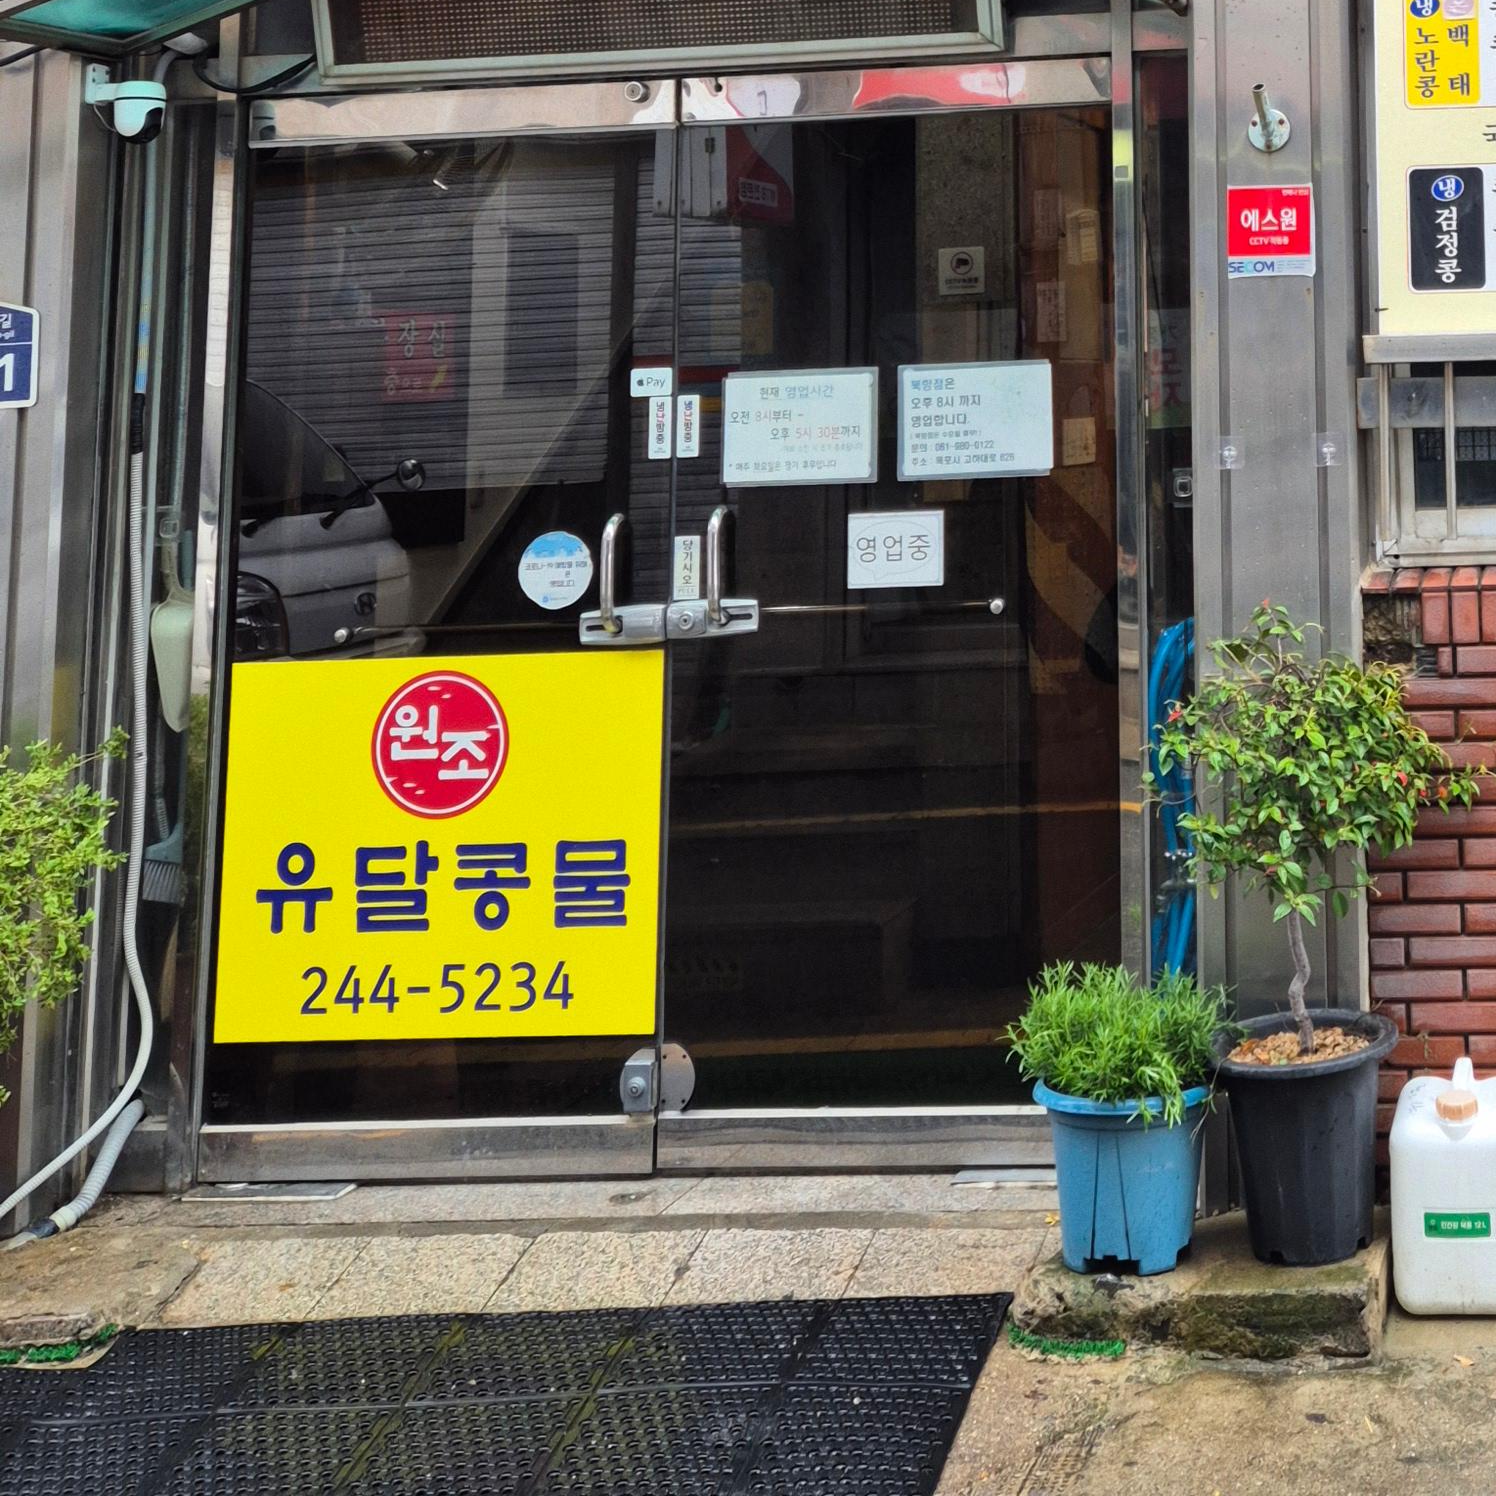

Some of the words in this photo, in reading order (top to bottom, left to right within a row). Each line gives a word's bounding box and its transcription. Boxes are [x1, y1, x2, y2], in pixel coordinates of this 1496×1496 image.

[1413, 27, 1440, 98] 노란콩
[1447, 24, 1470, 96] 백태
[1437, 178, 1457, 199] 냉
[1240, 207, 1297, 232] 에스원
[1434, 206, 1462, 283] 검정콩
[1228, 261, 1275, 273] SECOM
[646, 377, 666, 388] Pay
[911, 397, 933, 409] 오후
[936, 396, 954, 408] 8시
[959, 394, 981, 406] 까지
[729, 411, 750, 425] 오전
[770, 427, 791, 441] 오후
[682, 540, 693, 584] 당기시오
[856, 534, 931, 563] 영업중
[389, 704, 491, 780] 원조
[256, 838, 631, 934] 유달콩물
[300, 960, 575, 1015] 244-5234
